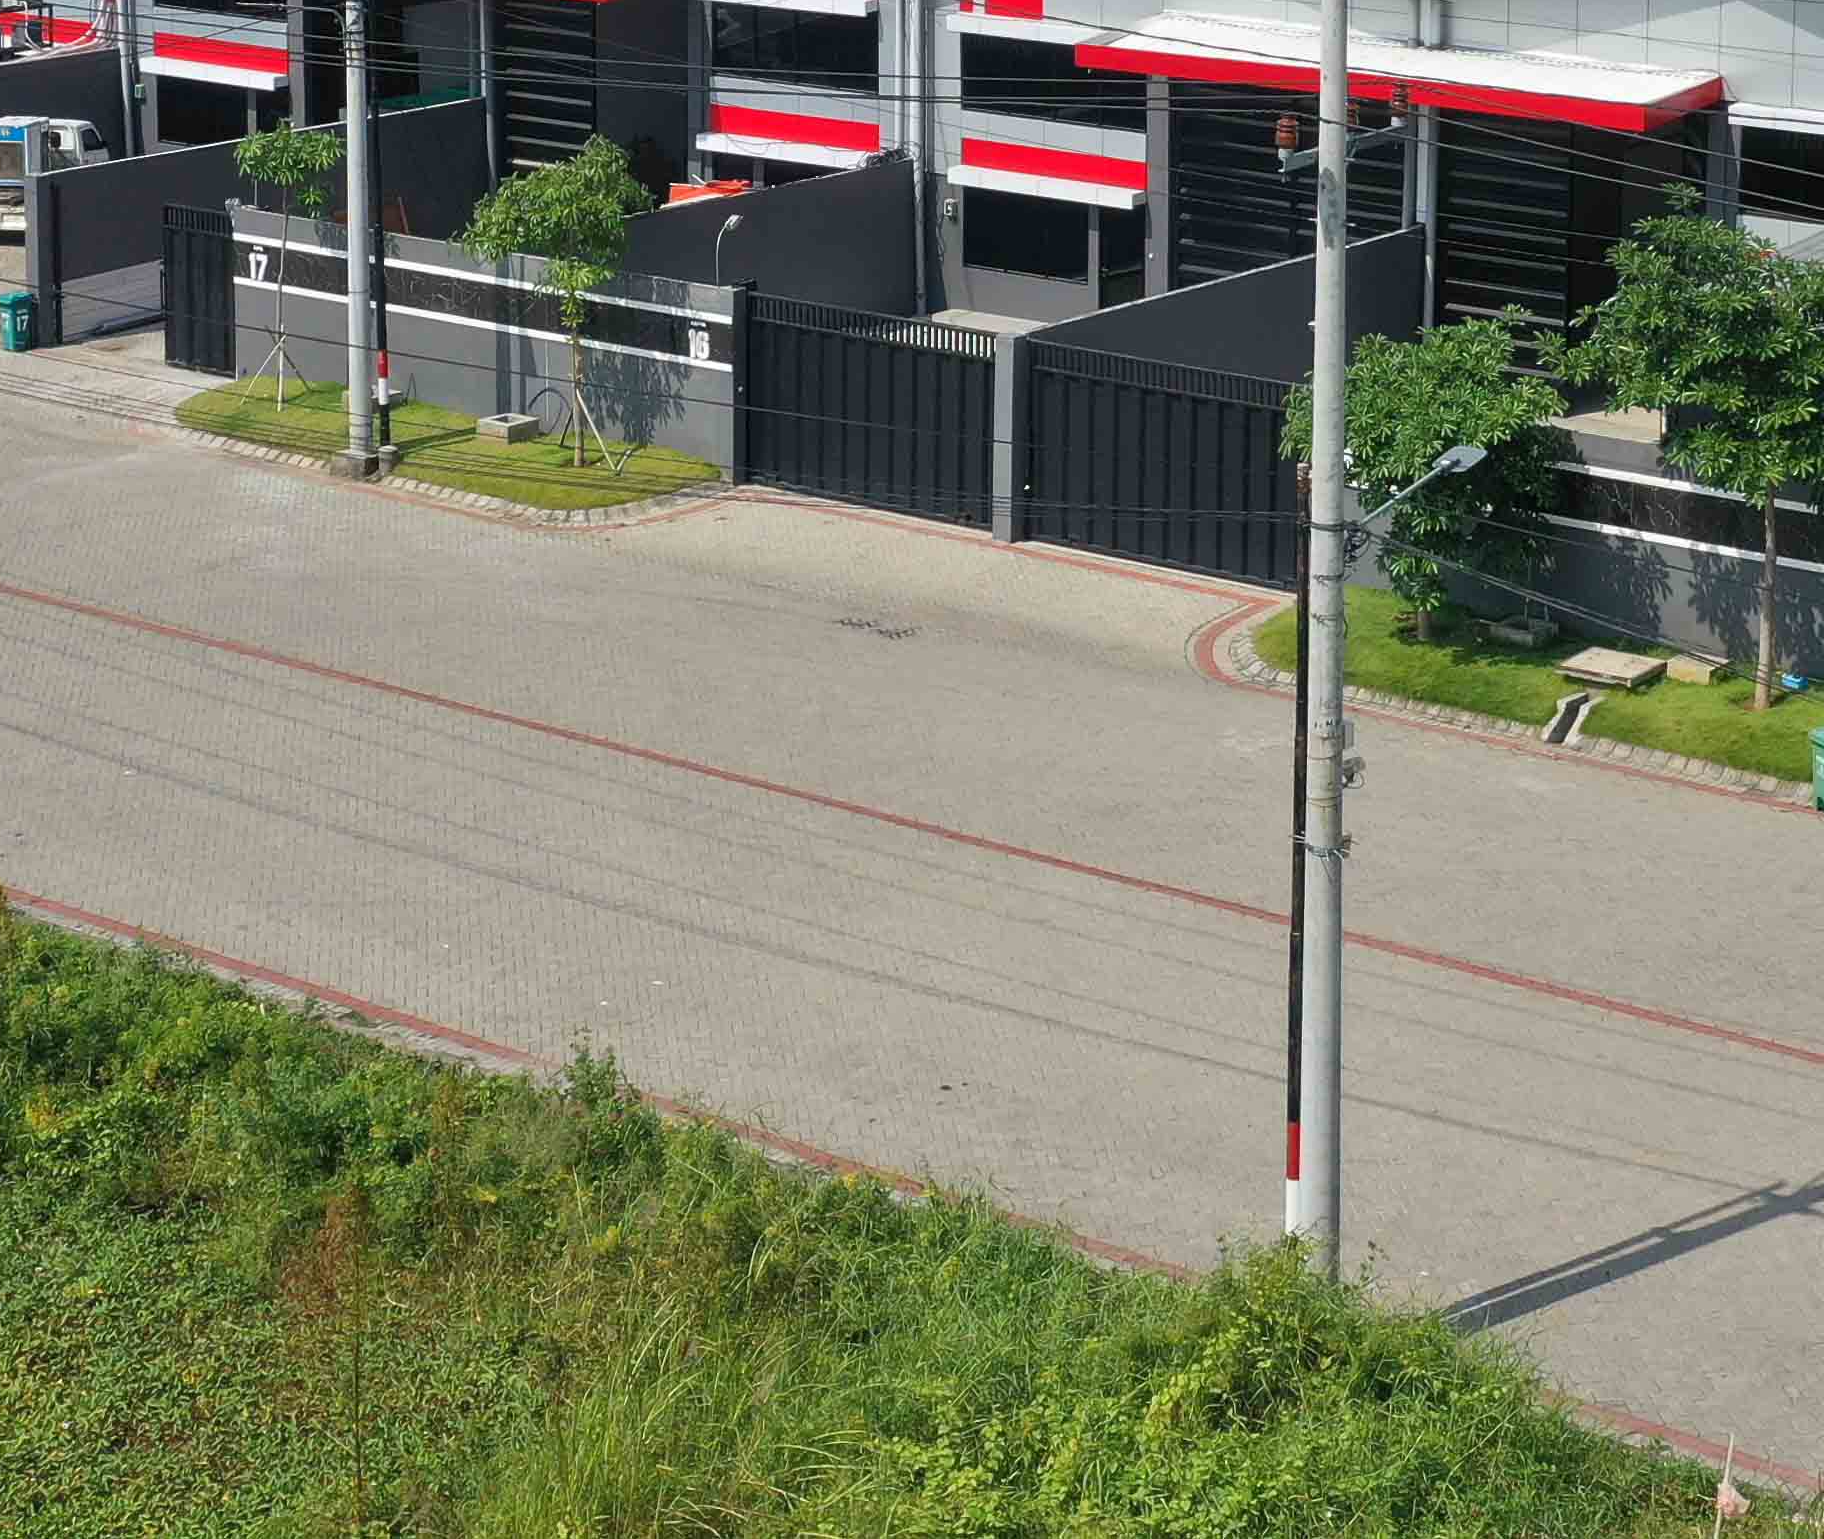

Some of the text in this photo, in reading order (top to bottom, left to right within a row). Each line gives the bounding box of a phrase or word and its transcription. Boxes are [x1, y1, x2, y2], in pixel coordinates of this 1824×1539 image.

[248, 252, 268, 281] 17
[16, 314, 29, 332] 17
[688, 328, 710, 360] 16
